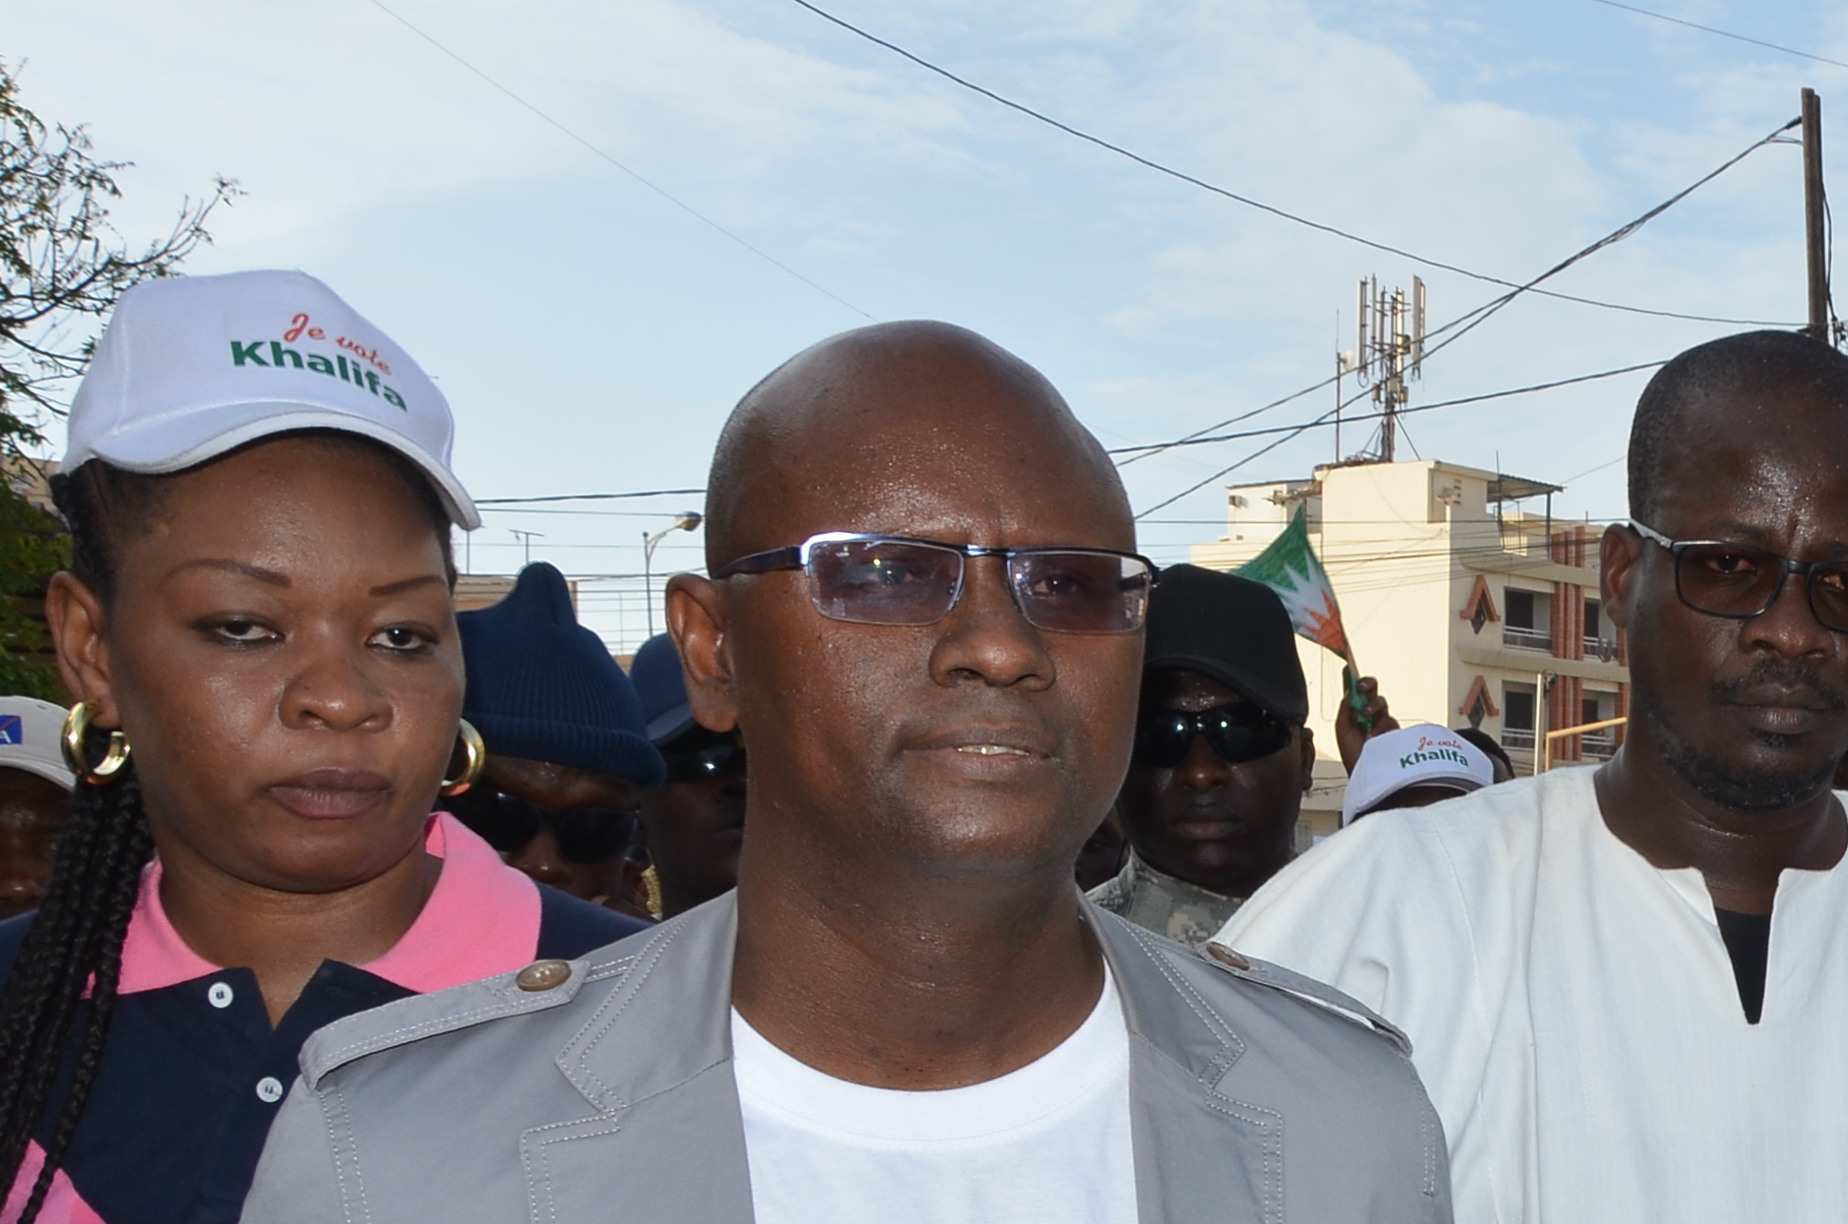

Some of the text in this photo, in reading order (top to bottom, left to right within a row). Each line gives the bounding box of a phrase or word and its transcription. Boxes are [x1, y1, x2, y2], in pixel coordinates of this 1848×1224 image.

[282, 312, 392, 376] Je vote
[230, 340, 407, 413] Khalifa
[1400, 748, 1469, 769] Khalifa
[1417, 736, 1434, 751] Je
